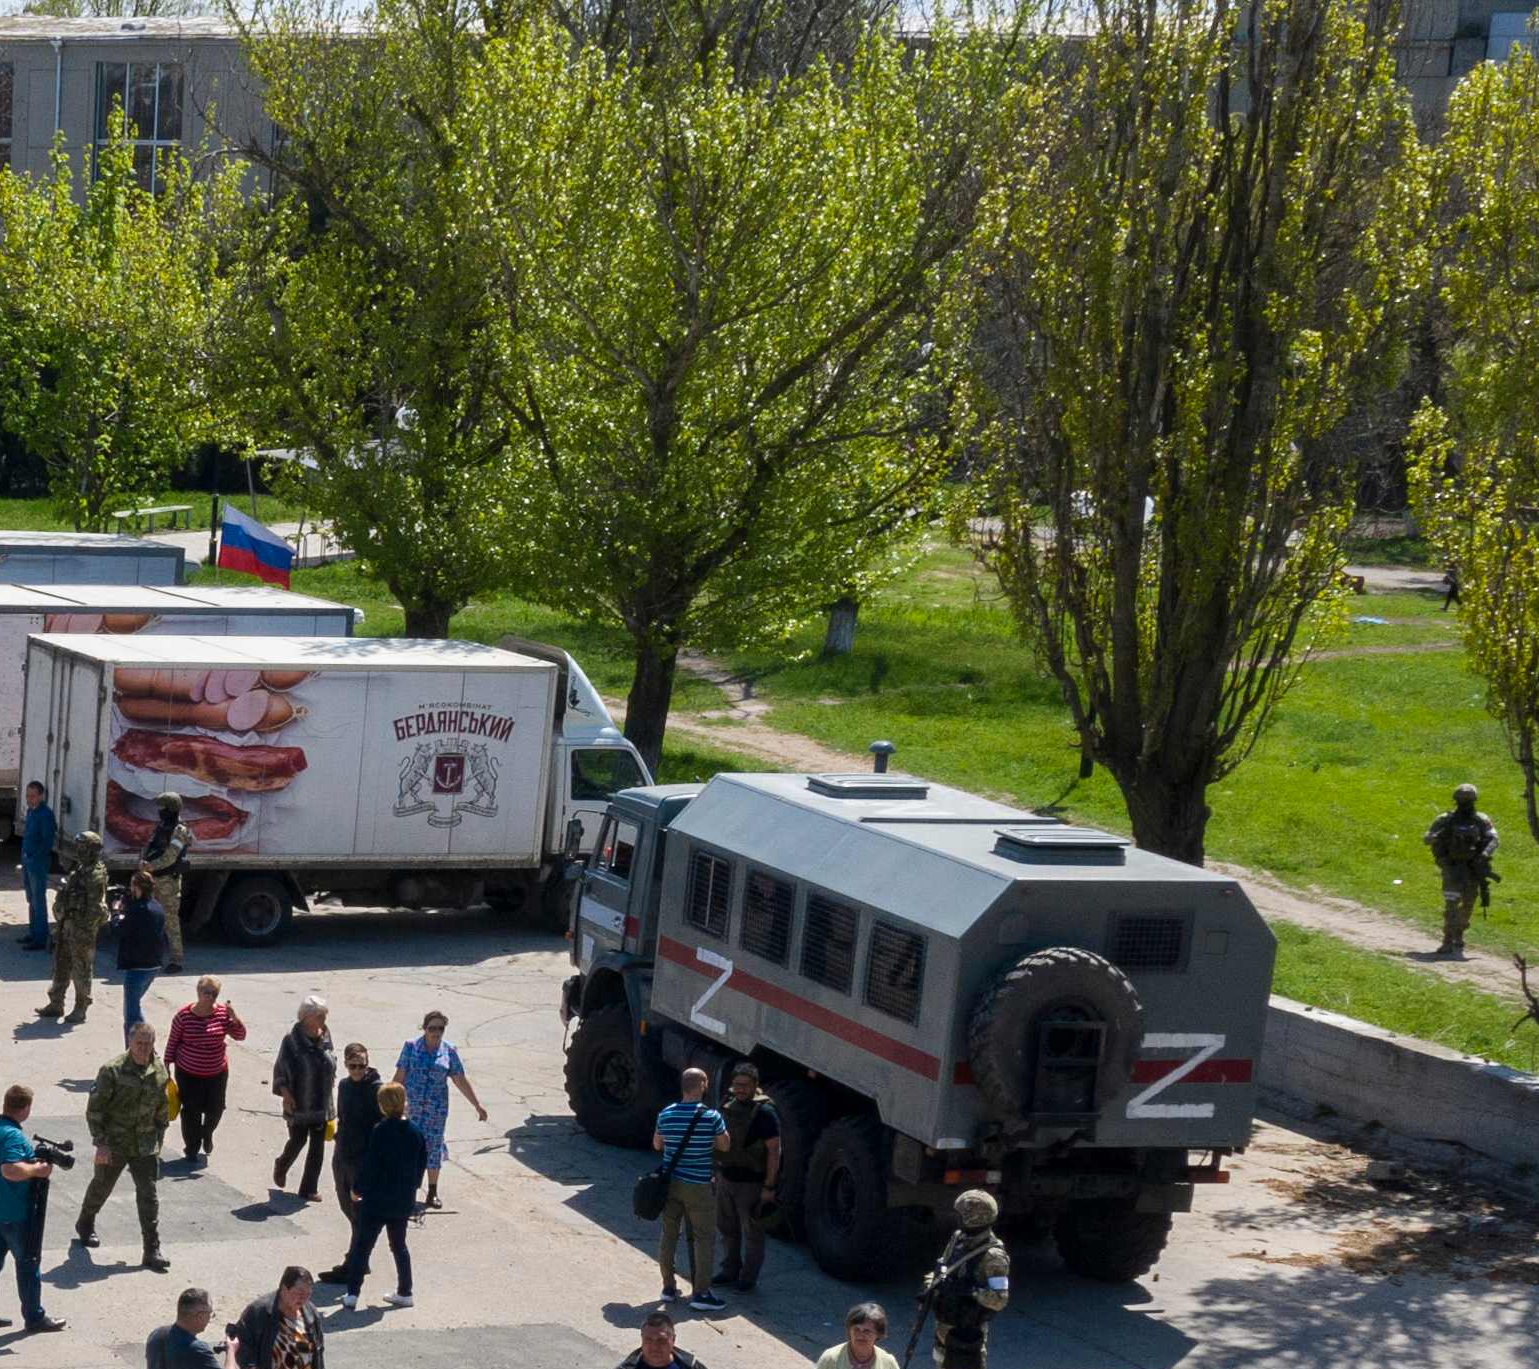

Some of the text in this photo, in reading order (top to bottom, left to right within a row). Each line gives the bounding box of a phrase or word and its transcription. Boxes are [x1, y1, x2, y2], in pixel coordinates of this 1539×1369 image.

[393, 710, 516, 743] БЕРДЯНСЬКИЙ
[690, 946, 734, 1035] Z
[1126, 1032, 1226, 1119] Z
